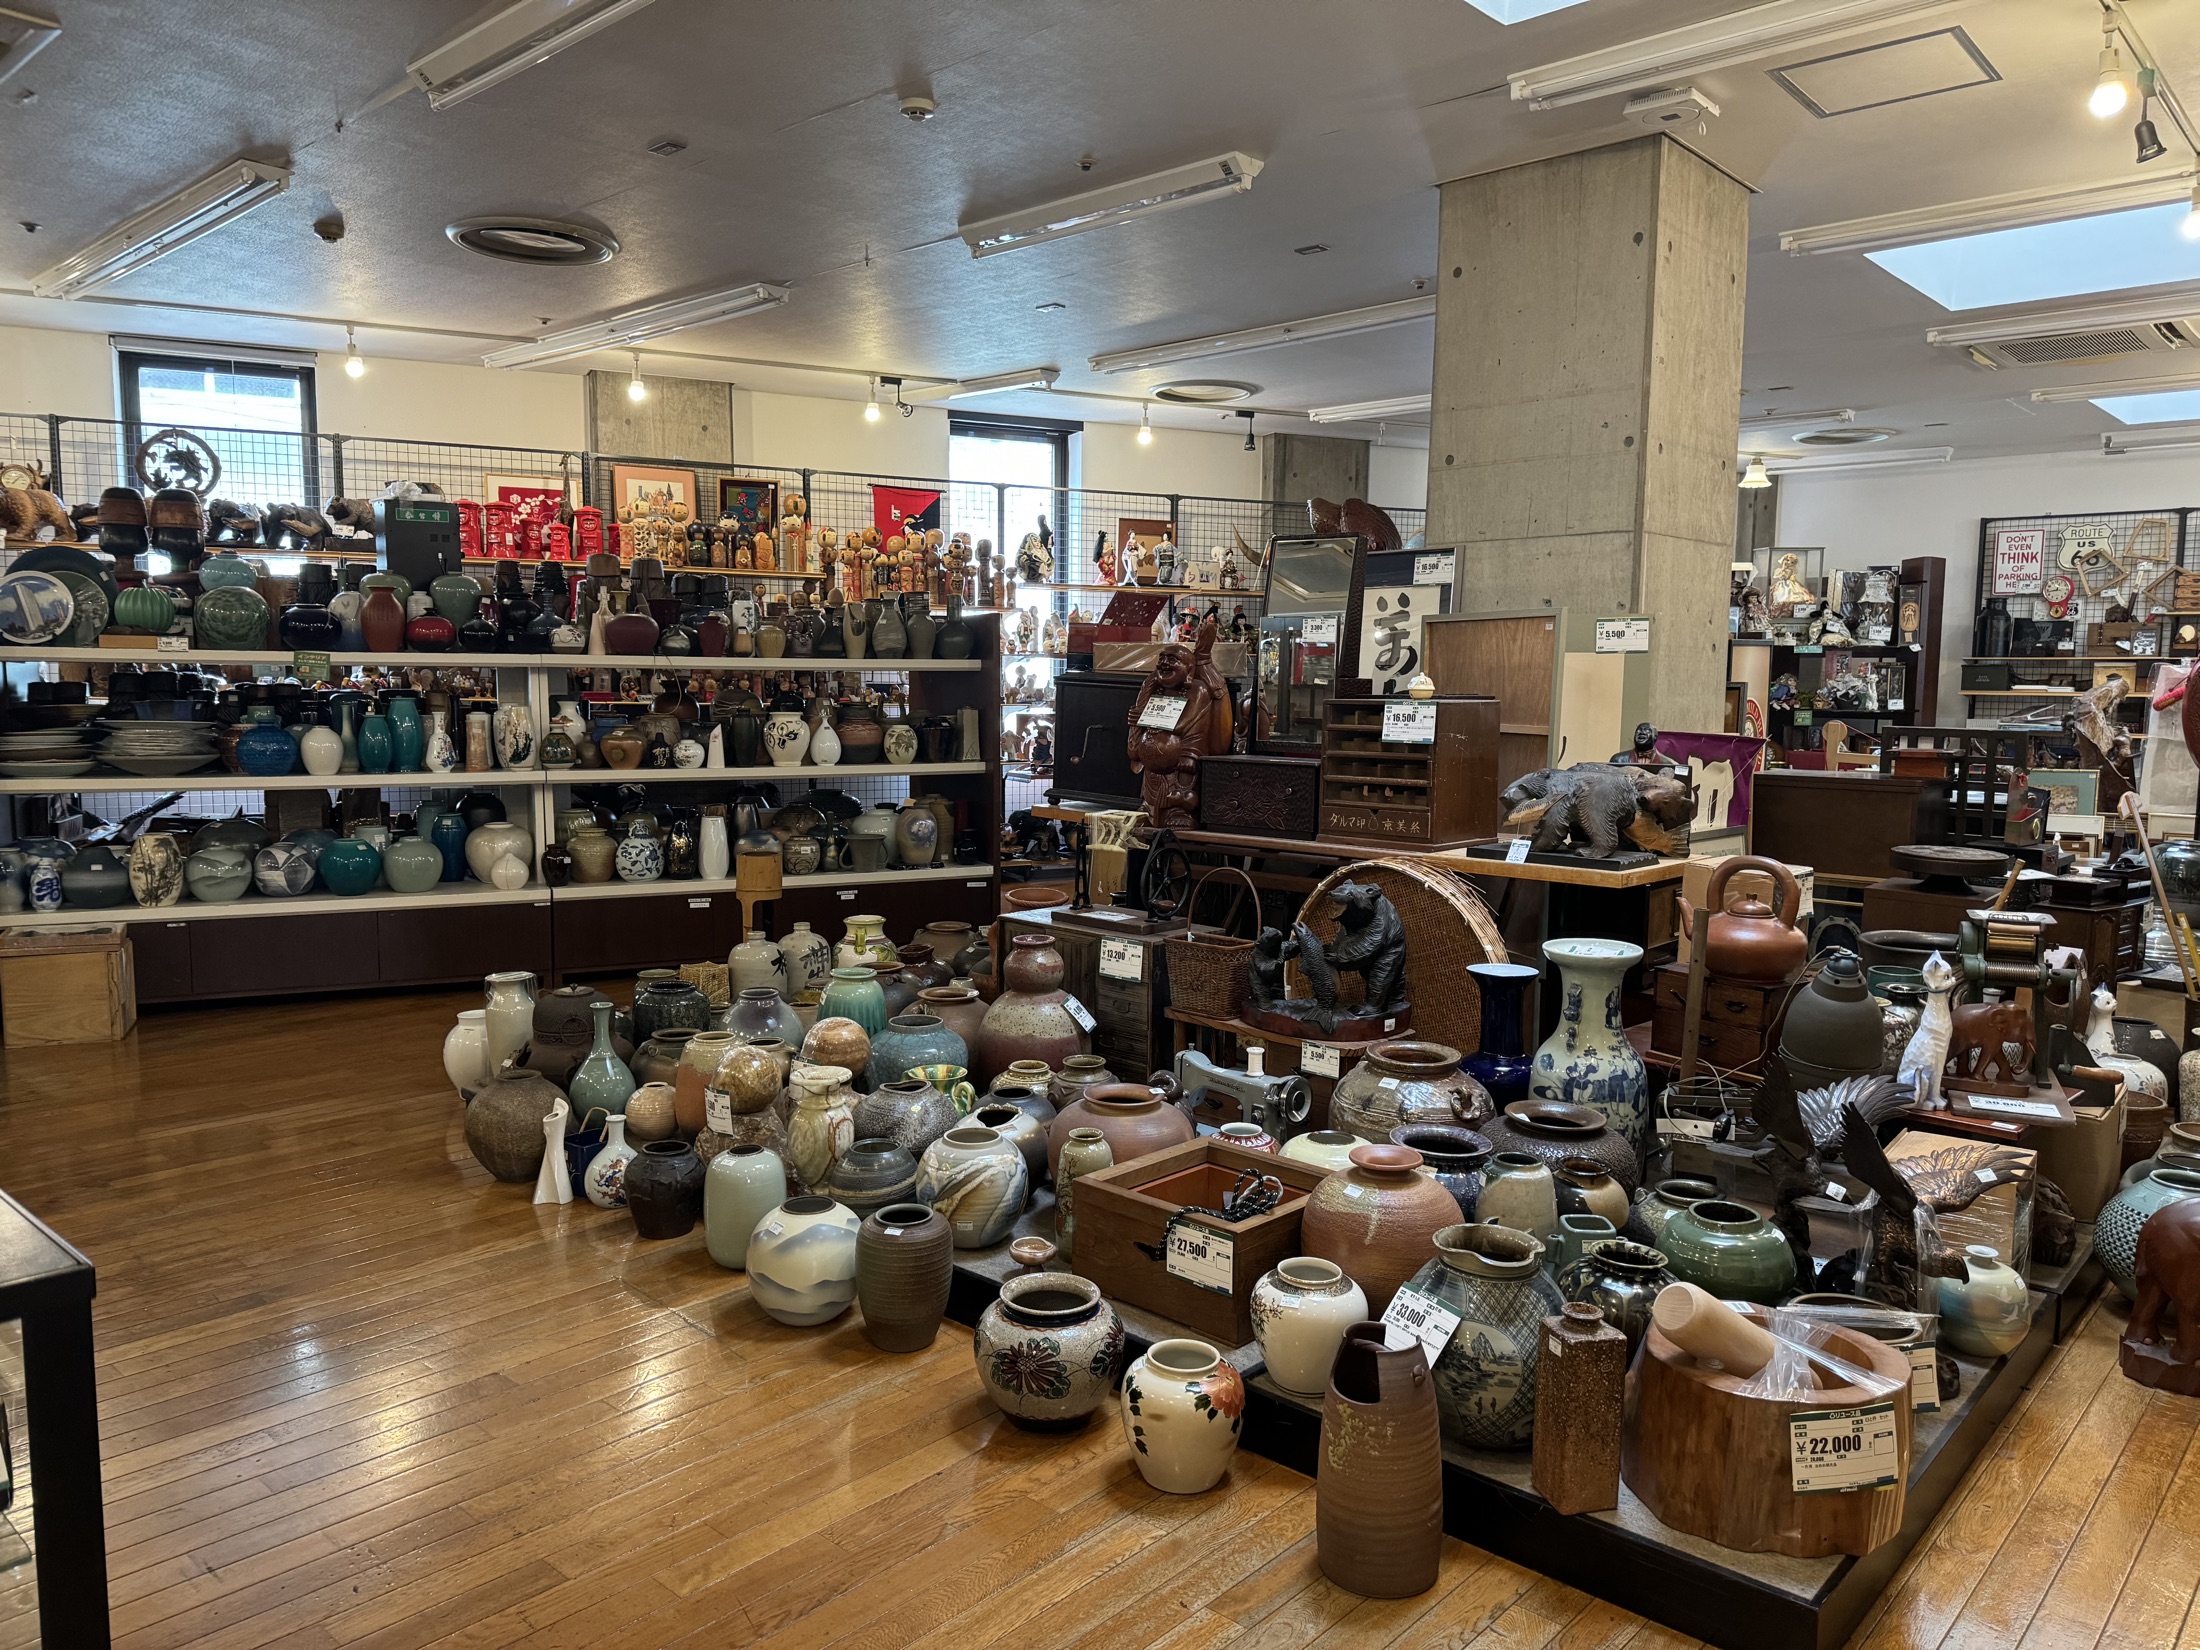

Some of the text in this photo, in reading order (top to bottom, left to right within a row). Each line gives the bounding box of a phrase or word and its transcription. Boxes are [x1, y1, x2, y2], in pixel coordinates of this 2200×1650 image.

[2070, 528, 2104, 538] ROUTE
[2006, 535, 2036, 543] DON'T
[2000, 552, 2039, 564] THINK
[1998, 573, 2038, 581] PARKING
[1330, 812, 1420, 834] ダルマ印 京美糸
